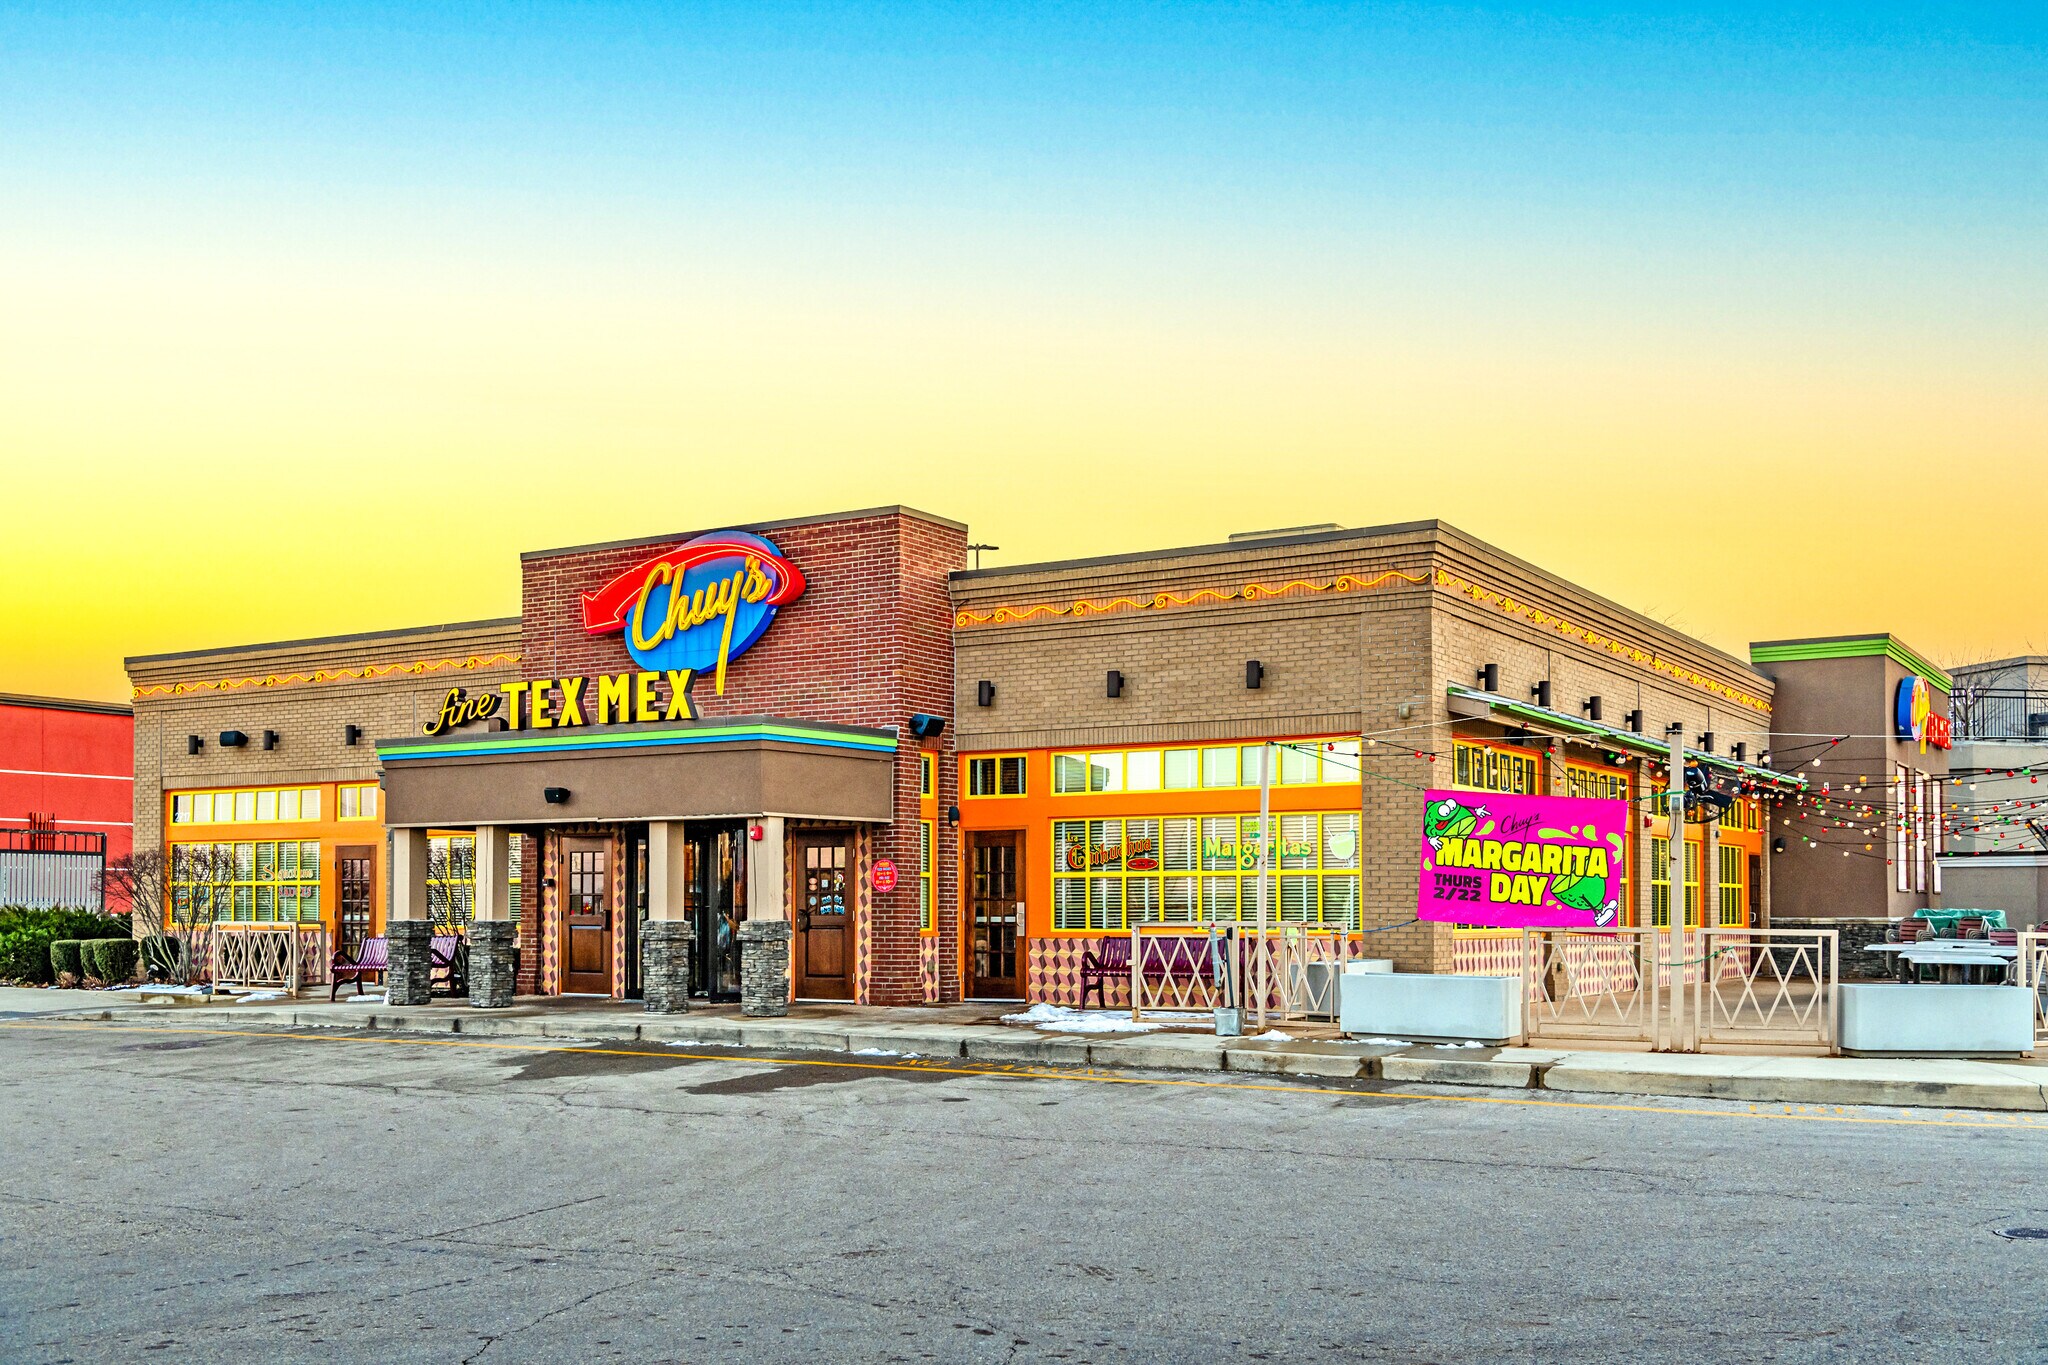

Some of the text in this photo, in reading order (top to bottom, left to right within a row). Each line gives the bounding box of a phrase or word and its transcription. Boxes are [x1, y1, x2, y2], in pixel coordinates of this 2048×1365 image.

[631, 554, 773, 696] Chuy's
[422, 668, 693, 736] fine TEX MEX
[1473, 752, 1523, 791] FINE
[1203, 836, 1312, 870] Margartas
[1434, 836, 1609, 878] MARGARITA
[1433, 887, 1481, 902] 2/22
[1434, 873, 1482, 888] THURS
[1489, 872, 1549, 906] DAY
